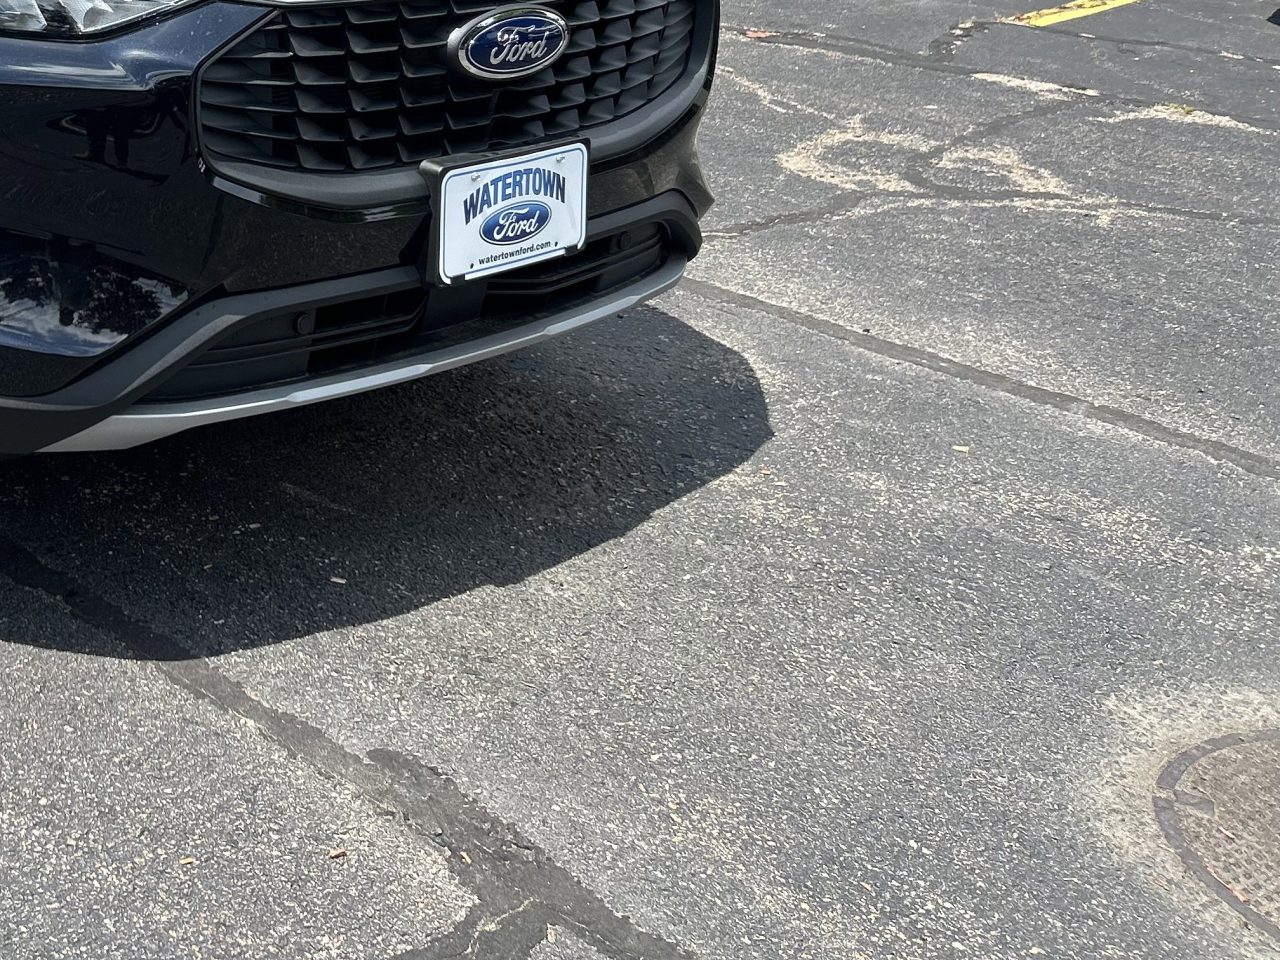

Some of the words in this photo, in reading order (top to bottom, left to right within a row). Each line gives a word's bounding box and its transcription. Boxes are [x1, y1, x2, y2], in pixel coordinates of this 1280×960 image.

[489, 24, 549, 65] Ford
[463, 167, 566, 225] WATERTOWN
[493, 207, 539, 241] Ford
[478, 240, 552, 266] watertownford.com
